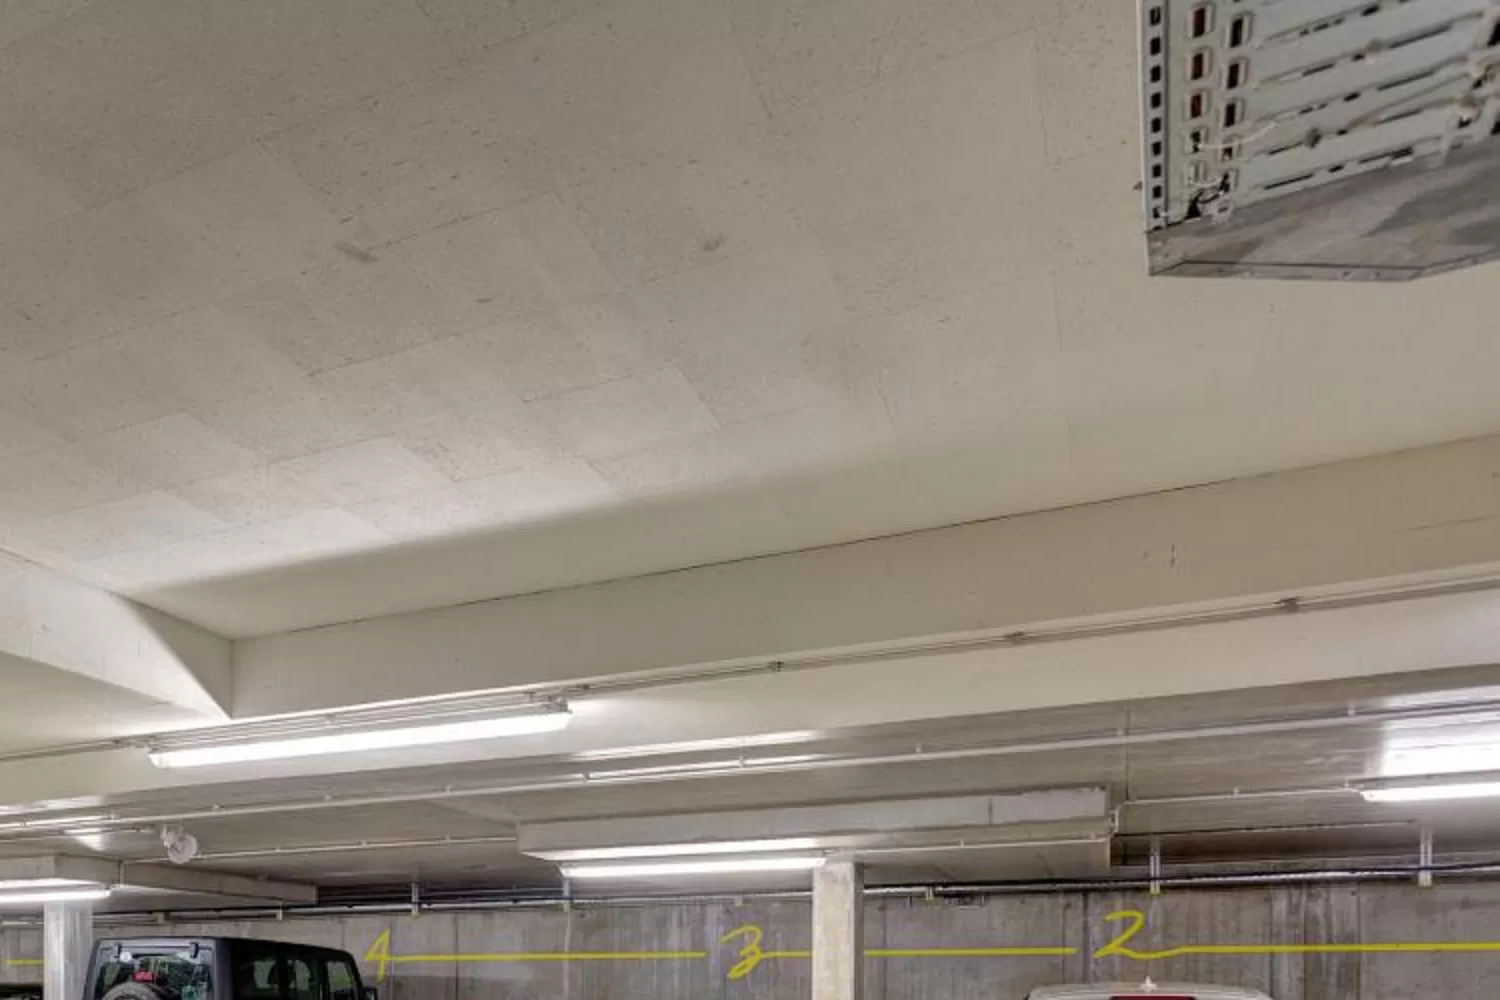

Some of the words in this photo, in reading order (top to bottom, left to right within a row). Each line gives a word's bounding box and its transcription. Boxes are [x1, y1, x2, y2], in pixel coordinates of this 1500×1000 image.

[364, 927, 389, 983] 4
[720, 925, 763, 979] 3
[1092, 908, 1159, 959] 2
